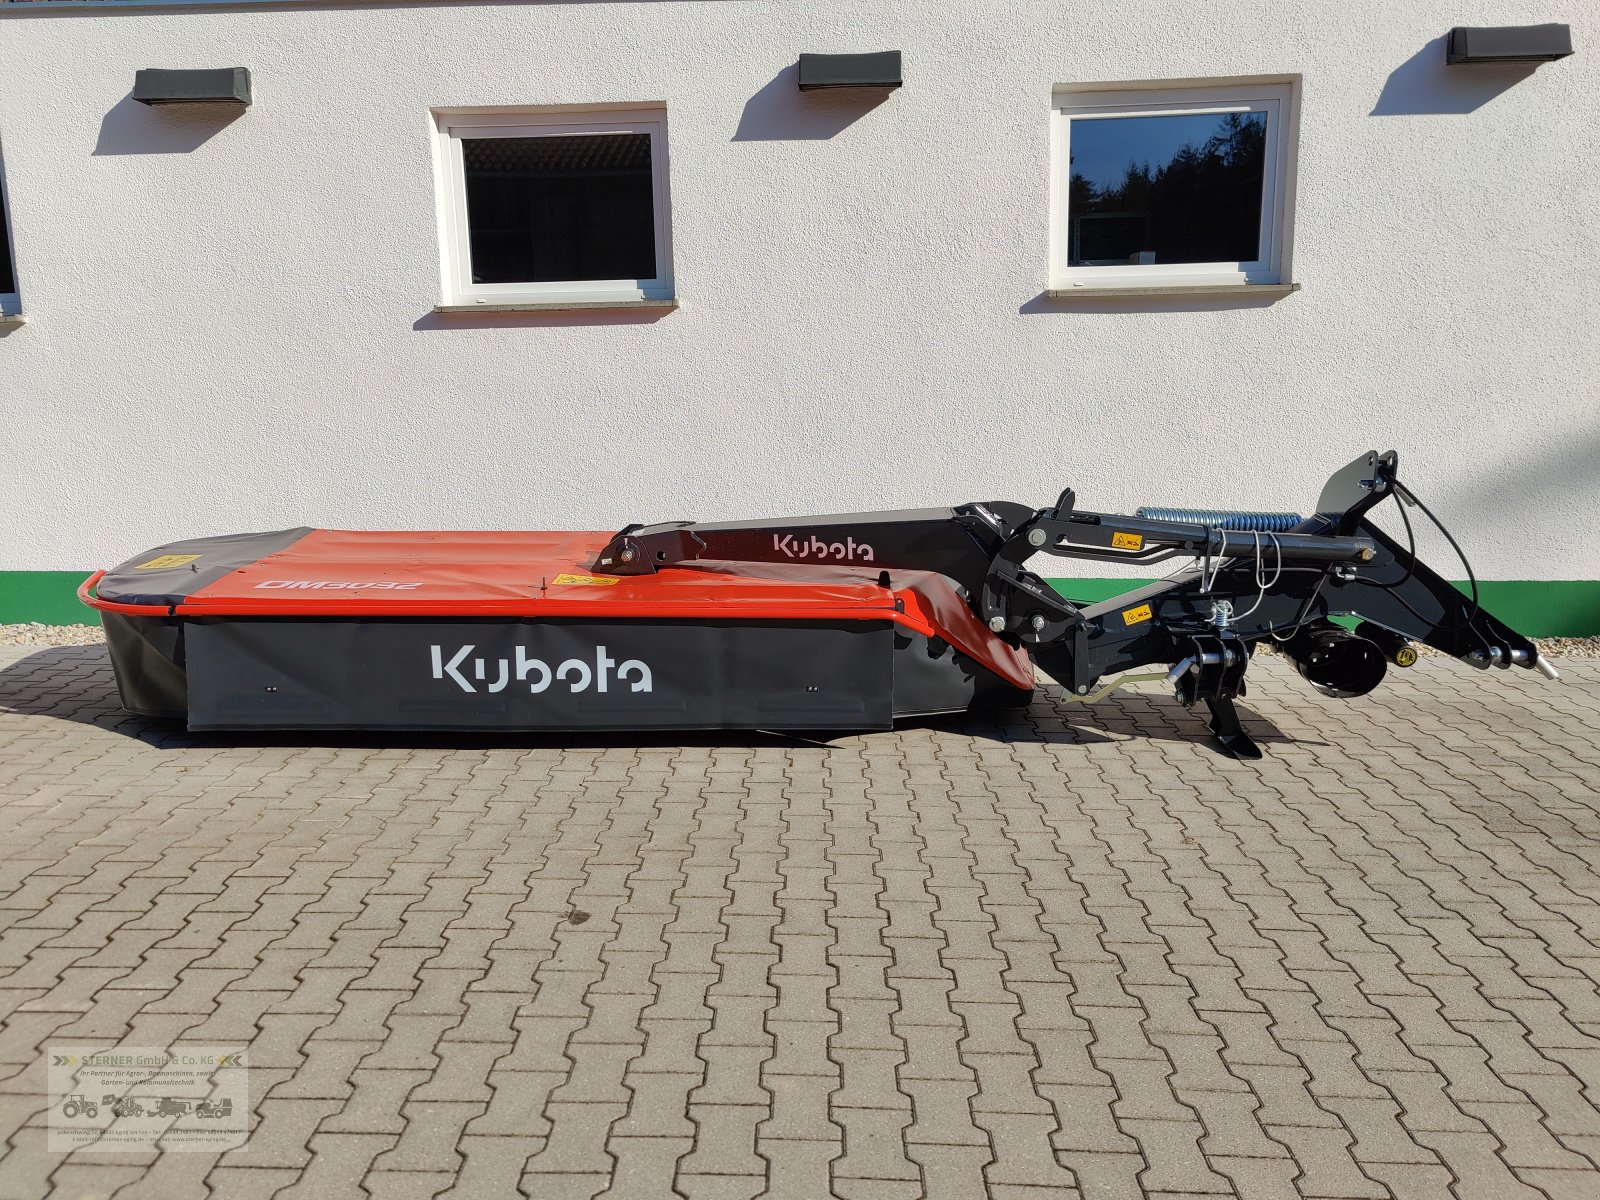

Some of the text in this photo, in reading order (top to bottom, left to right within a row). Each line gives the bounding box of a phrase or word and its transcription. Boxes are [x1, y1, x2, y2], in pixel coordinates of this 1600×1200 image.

[773, 533, 874, 561] Kubota
[253, 580, 424, 590] DM3032
[430, 644, 653, 694] Kubota
